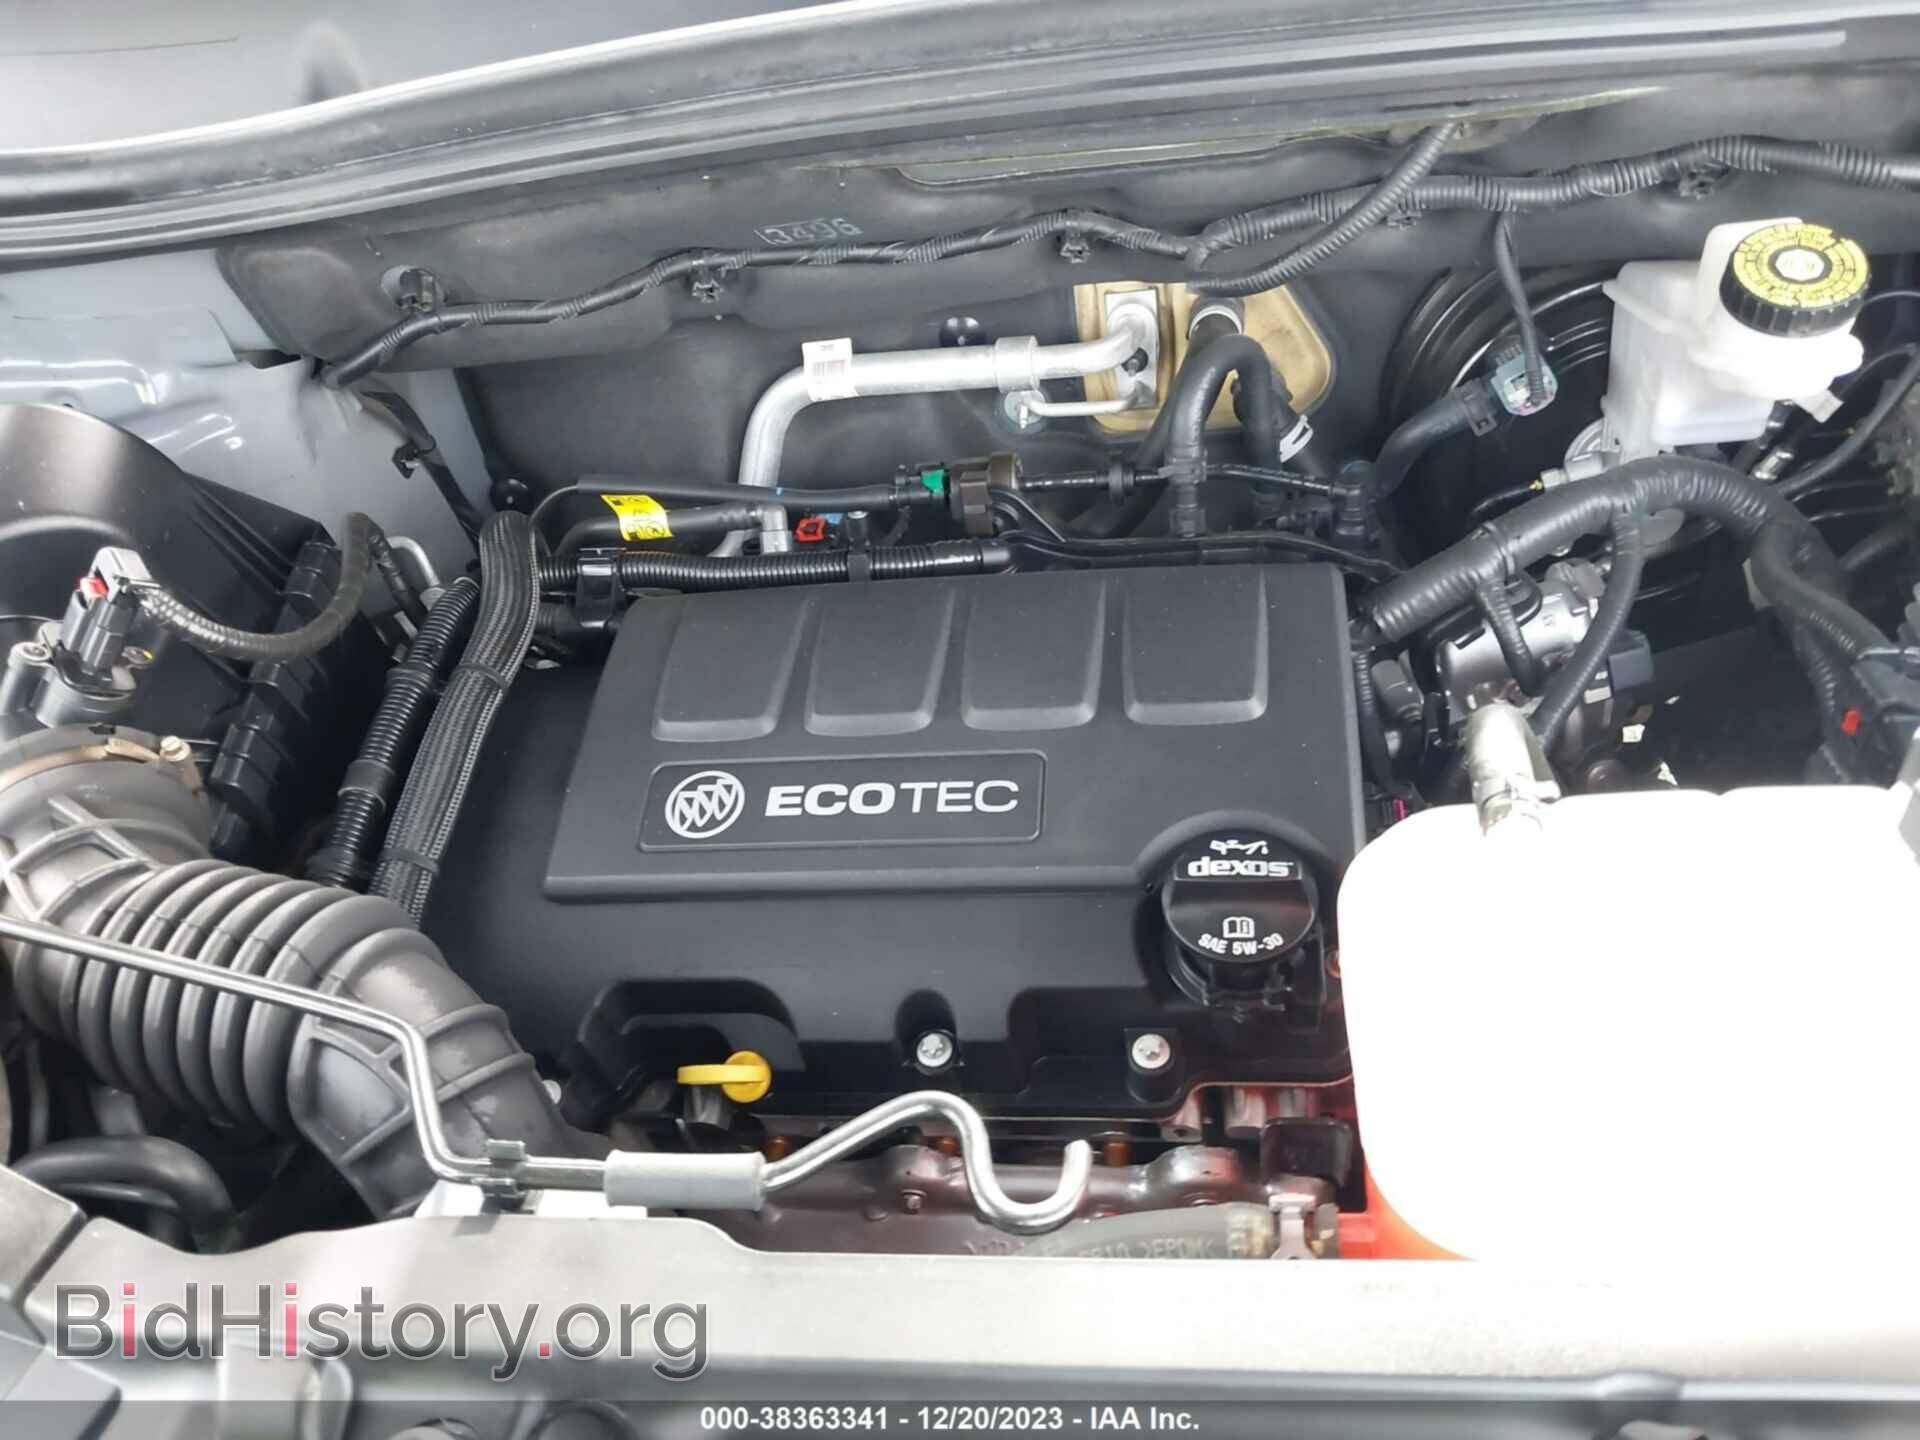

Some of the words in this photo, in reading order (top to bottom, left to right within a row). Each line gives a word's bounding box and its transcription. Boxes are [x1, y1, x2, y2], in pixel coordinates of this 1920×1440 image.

[764, 779, 1020, 817] ECOTEC
[1187, 856, 1293, 877] dexos
[1197, 933, 1228, 954] SAE
[1231, 932, 1284, 955] 5W-30
